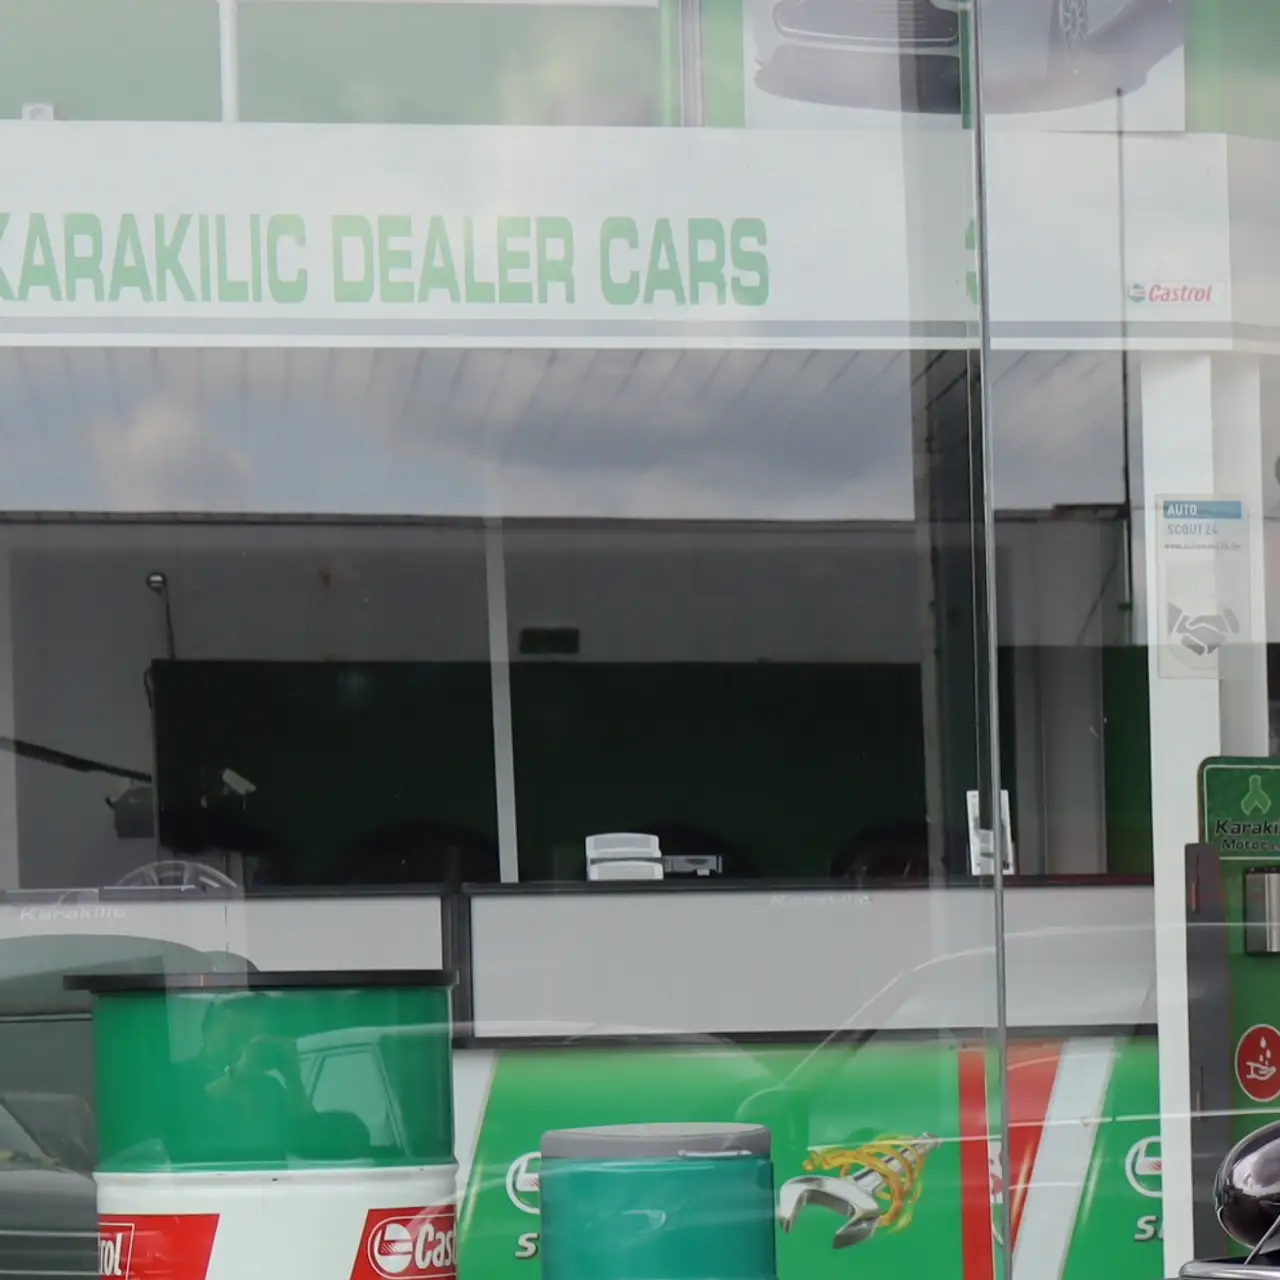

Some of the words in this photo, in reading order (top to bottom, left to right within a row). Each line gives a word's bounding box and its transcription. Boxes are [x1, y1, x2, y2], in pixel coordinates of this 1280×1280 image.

[331, 215, 576, 305] DEALER
[600, 216, 770, 307] CARS
[1148, 282, 1214, 304] Castrol
[1166, 503, 1198, 517] AUTO
[1221, 838, 1275, 851] Motors
